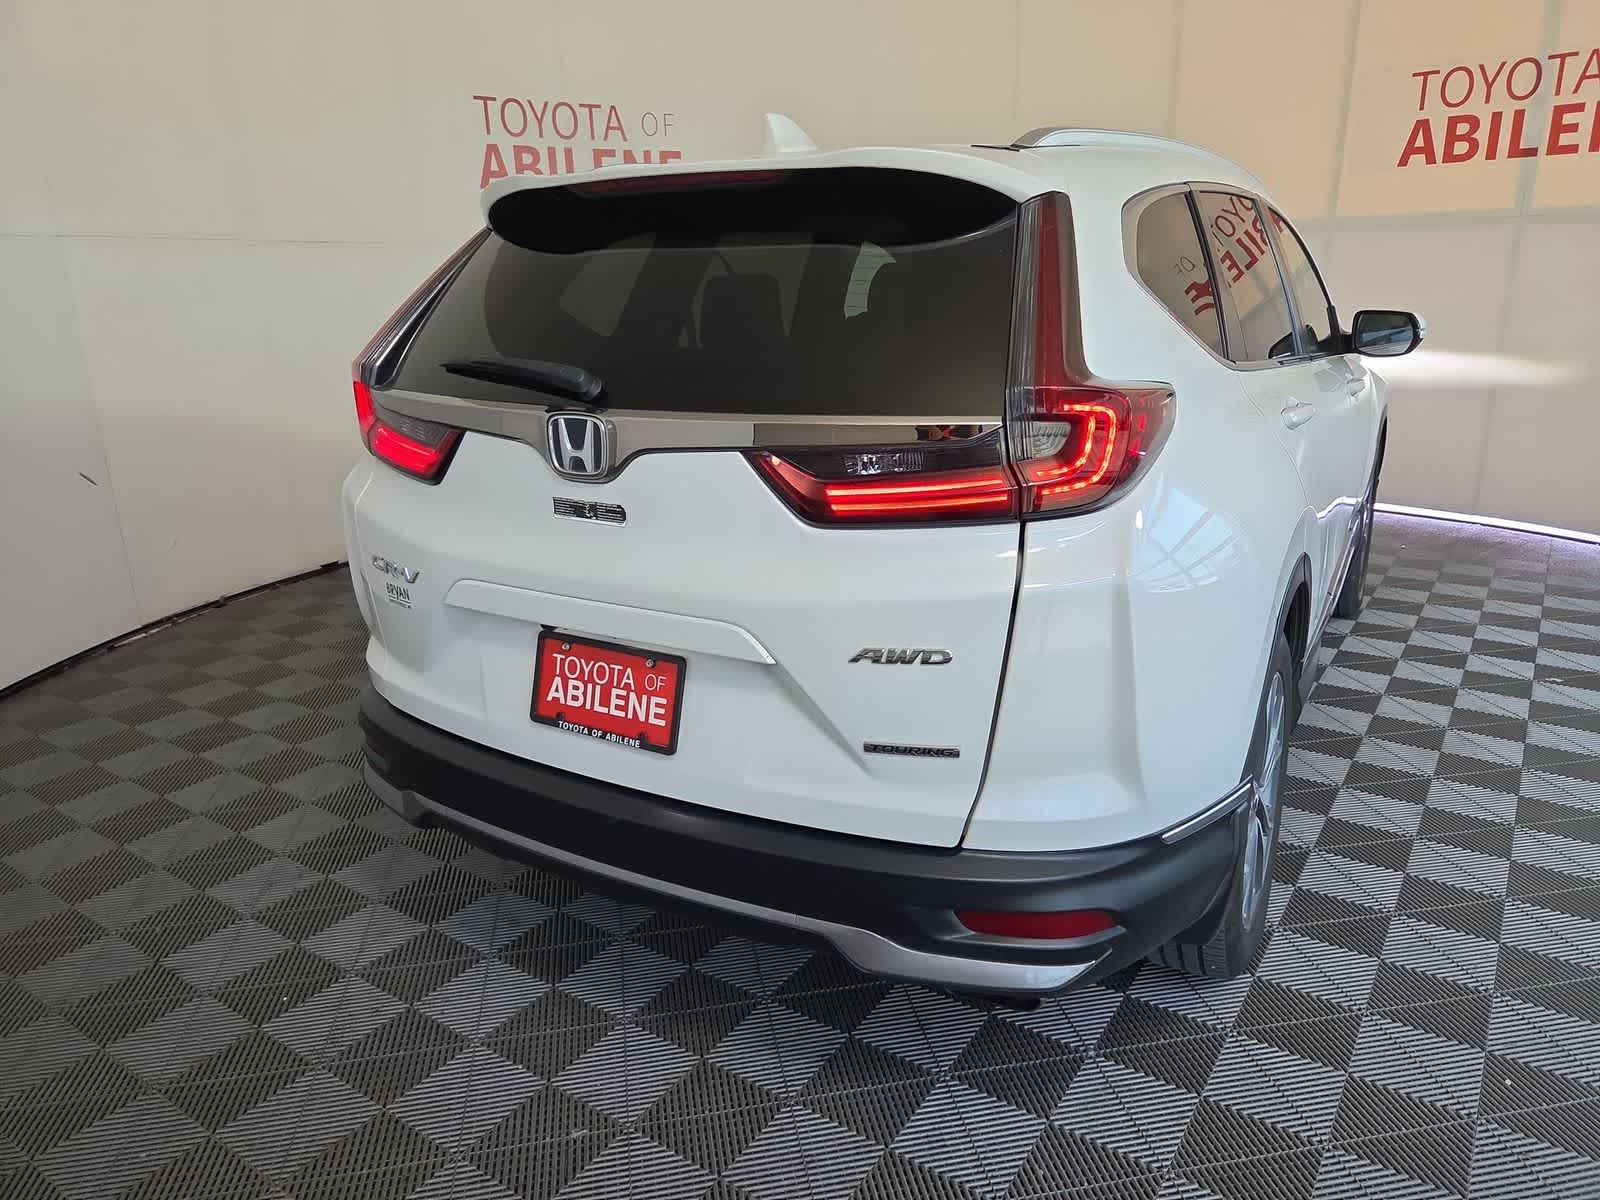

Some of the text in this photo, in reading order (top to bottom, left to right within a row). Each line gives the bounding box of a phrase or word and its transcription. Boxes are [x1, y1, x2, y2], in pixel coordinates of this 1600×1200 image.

[472, 95, 675, 142] TOYOTA OF
[1397, 100, 1600, 167] ABILE
[552, 653, 668, 692] TOYOTA OF
[848, 648, 953, 664] AWD
[546, 676, 668, 727] ABILENE
[558, 720, 641, 748] TOYOTA OF ABILENE
[866, 742, 957, 758] TOURING
